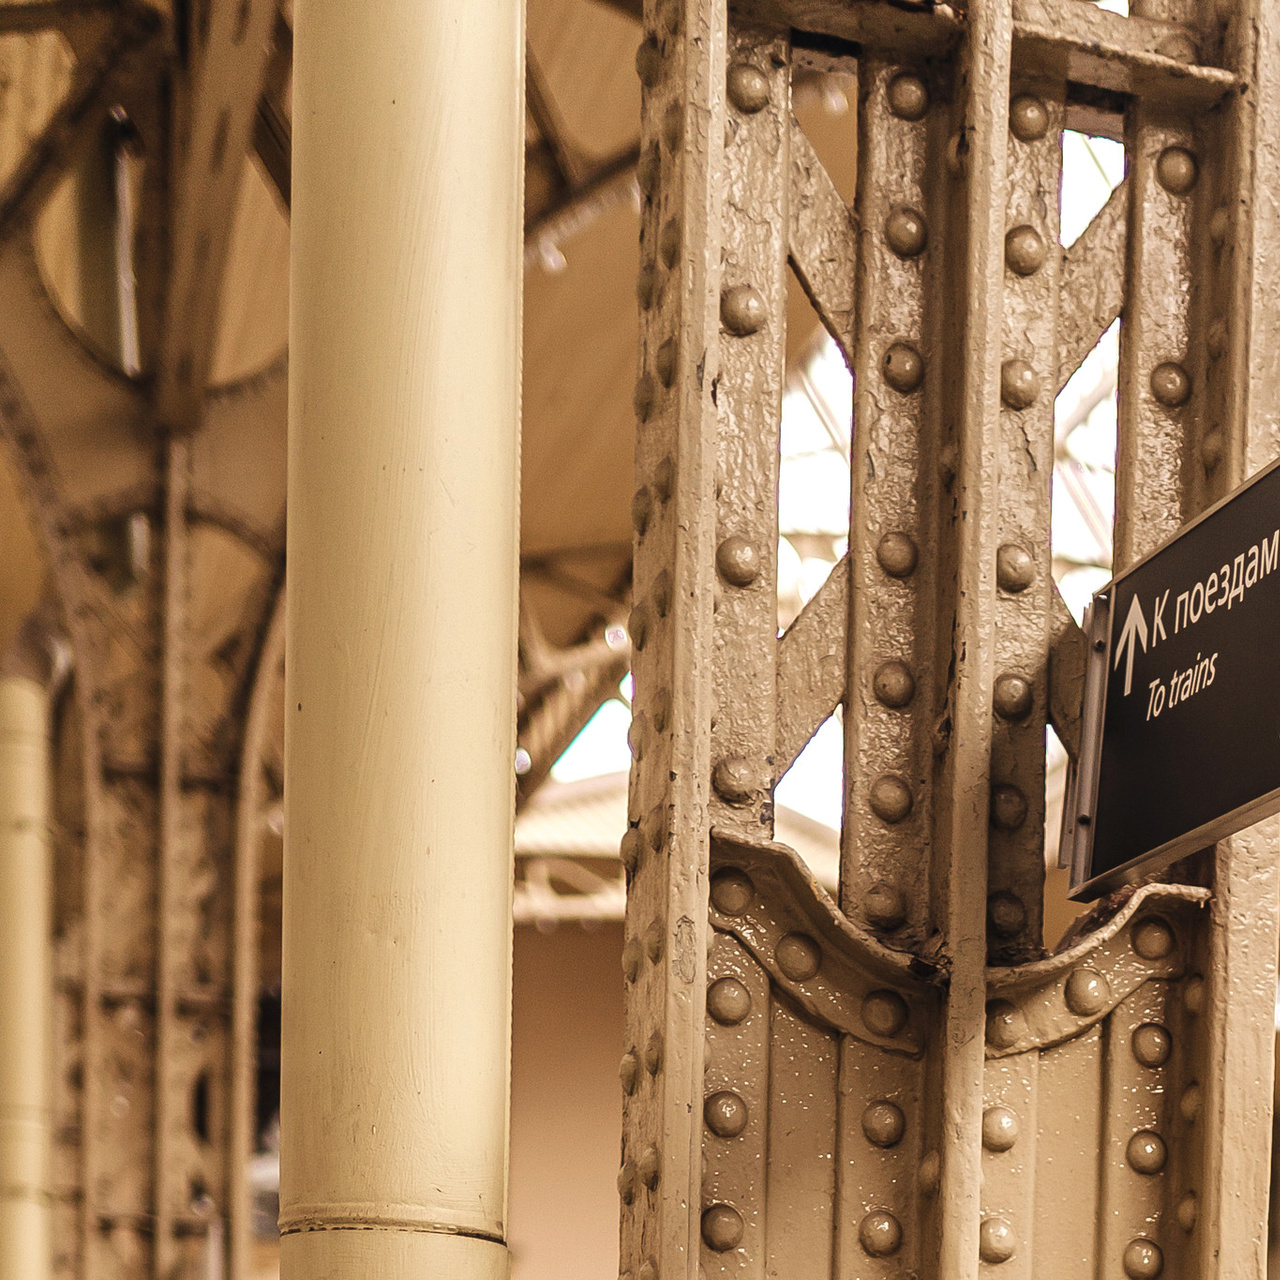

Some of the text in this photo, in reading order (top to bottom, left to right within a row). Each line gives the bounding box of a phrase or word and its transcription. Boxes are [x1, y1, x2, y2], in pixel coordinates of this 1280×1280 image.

[1152, 528, 1280, 648] К поездам
[1146, 651, 1219, 722] To trains
